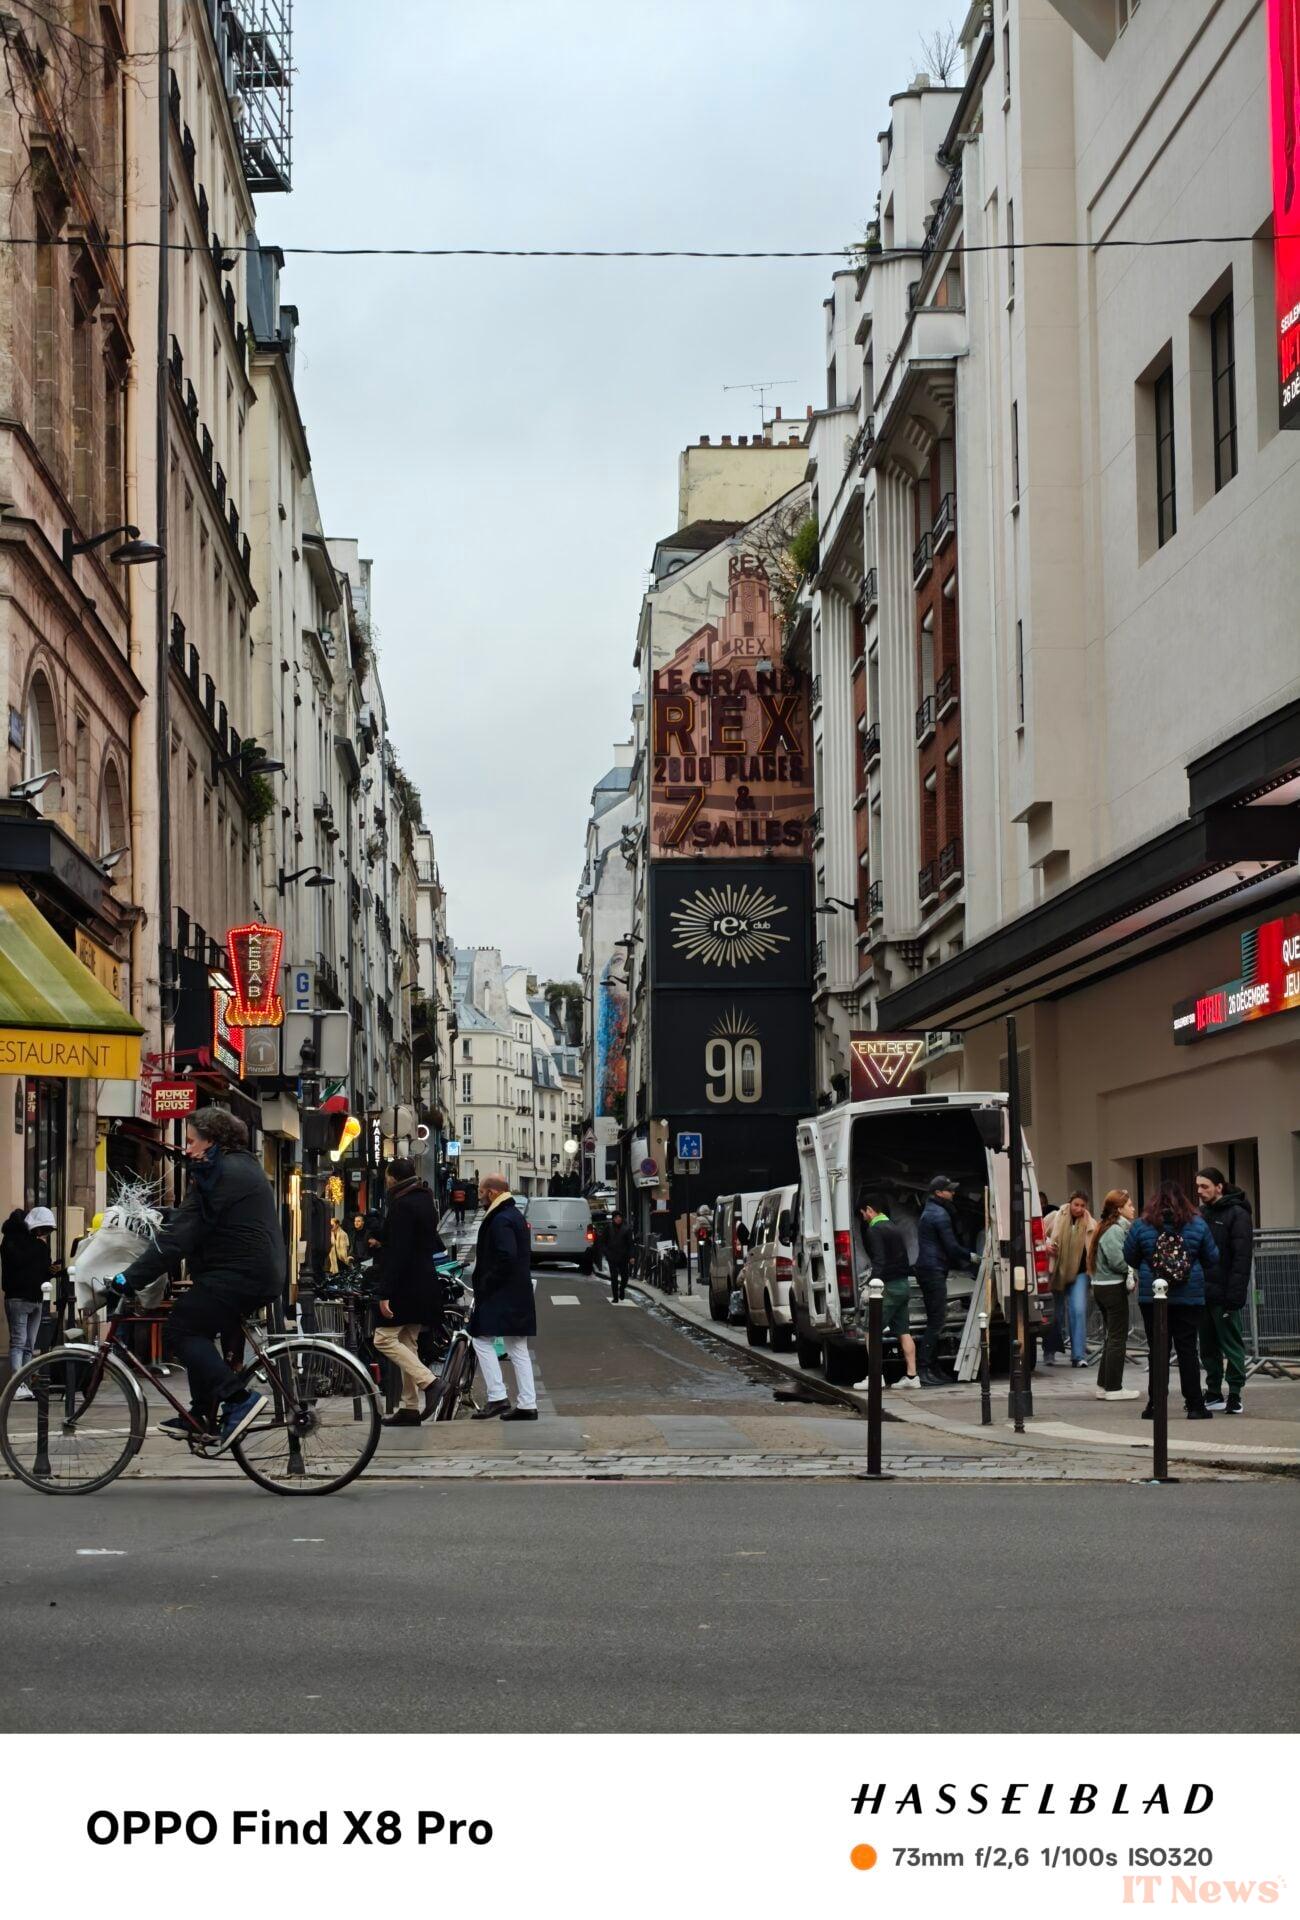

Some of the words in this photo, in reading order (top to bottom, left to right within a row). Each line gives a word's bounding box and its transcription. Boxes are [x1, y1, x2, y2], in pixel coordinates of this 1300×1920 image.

[1282, 385, 1291, 407] 26
[728, 554, 768, 577] REX
[734, 638, 767, 655] REX
[654, 670, 682, 694] LE
[690, 669, 801, 695] GRAND
[654, 695, 803, 756] REX
[654, 757, 712, 783] 2800
[725, 756, 804, 783] PLACES
[736, 786, 755, 809] &
[664, 786, 706, 848] 7
[692, 820, 804, 848] SALLES
[713, 916, 748, 937] rex
[753, 921, 771, 930] club
[248, 933, 262, 998] KEBAB
[1284, 971, 1300, 998] JEU
[1196, 992, 1223, 1031] NETFLIX
[1229, 994, 1236, 1014] 26
[1236, 983, 1270, 1012] DÉCEMBRE
[258, 1047, 264, 1061] 1
[858, 1043, 914, 1054] ENTREE
[705, 1038, 762, 1103] 90
[881, 1055, 894, 1075] 4
[154, 1089, 194, 1101] MOMO
[155, 1100, 194, 1112] HOUSE
[372, 1119, 381, 1167] MARKET
